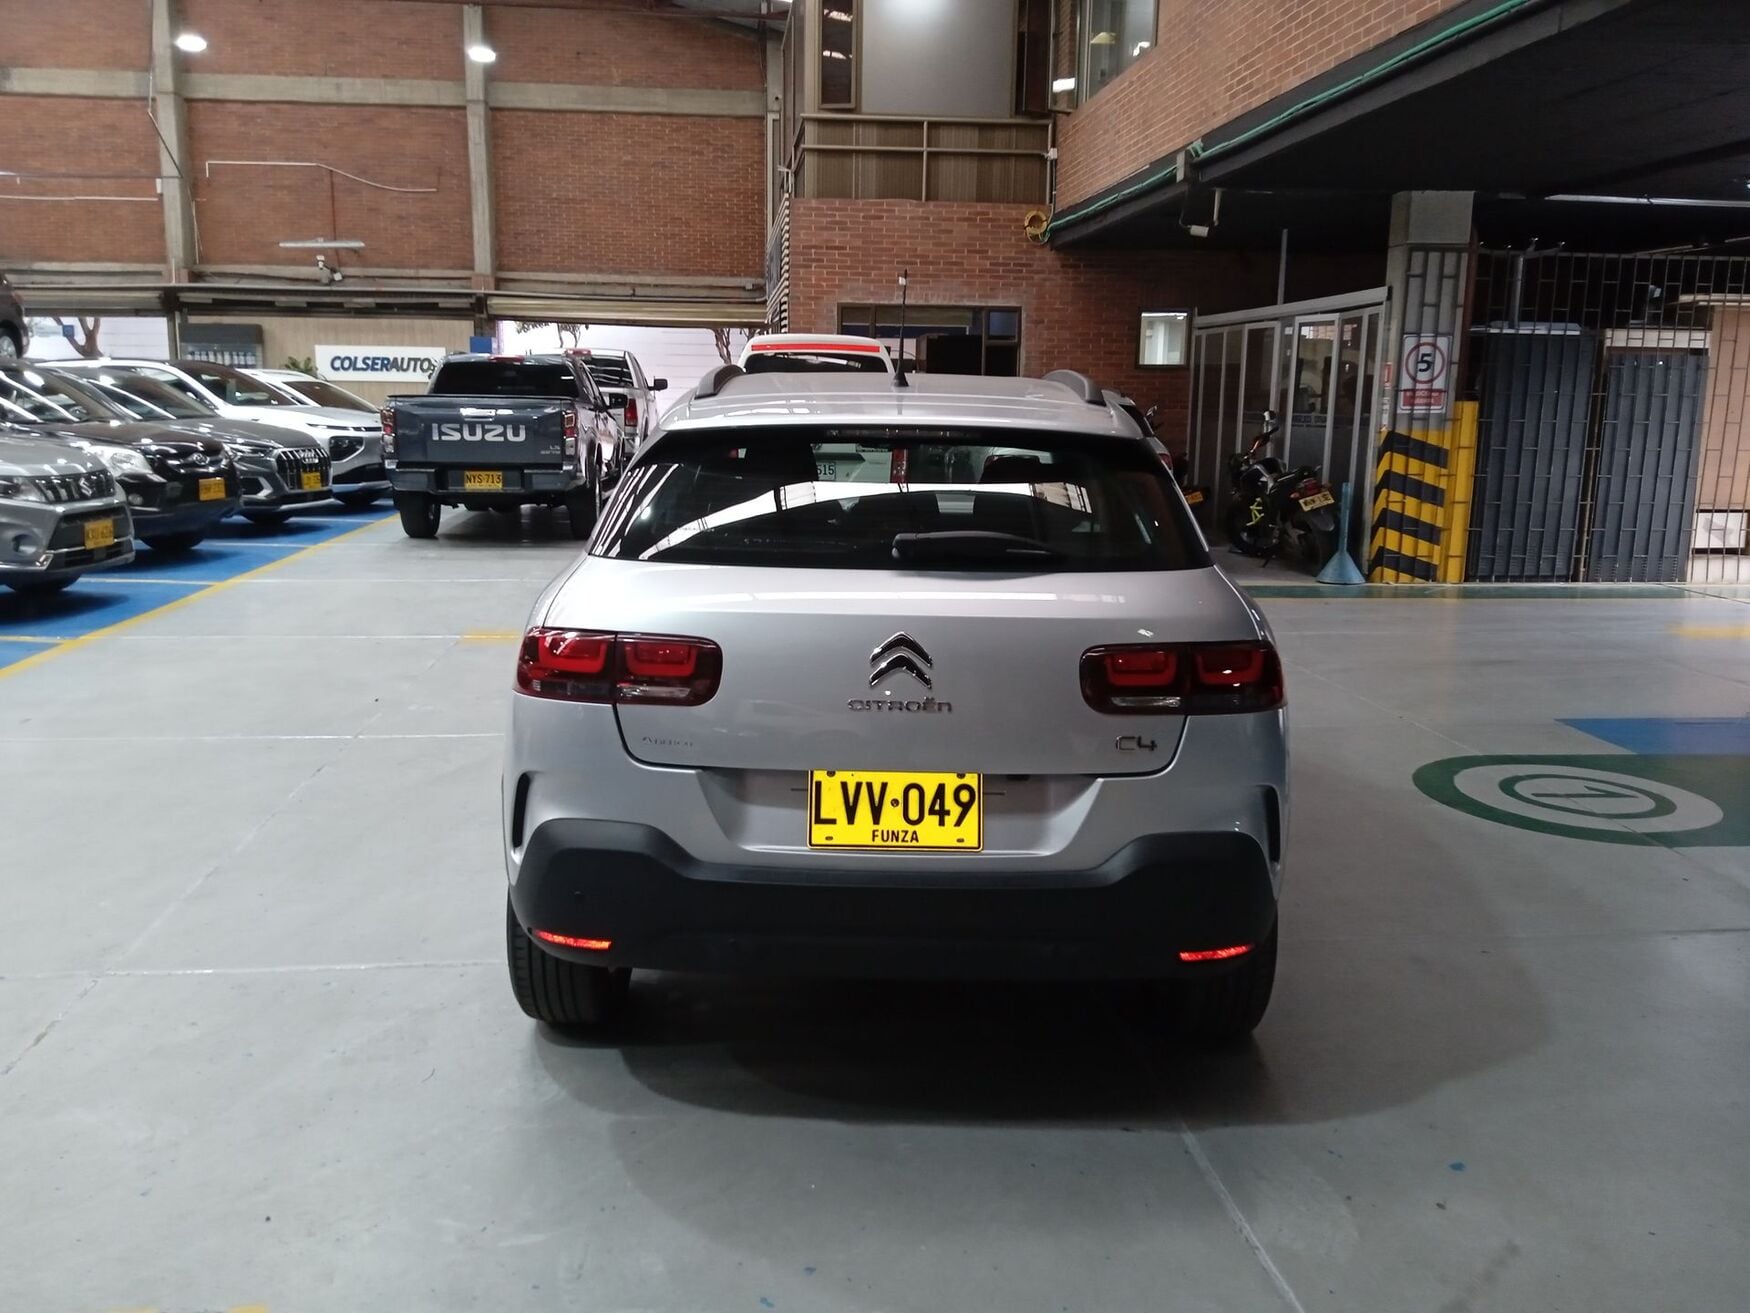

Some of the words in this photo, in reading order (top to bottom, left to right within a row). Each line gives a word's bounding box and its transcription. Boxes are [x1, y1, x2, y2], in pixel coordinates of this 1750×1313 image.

[330, 355, 432, 373] COLSERAUTO
[1416, 352, 1433, 373] 5
[431, 423, 527, 442] ISUZU
[1115, 735, 1158, 751] C4
[871, 829, 919, 843] FUNZA
